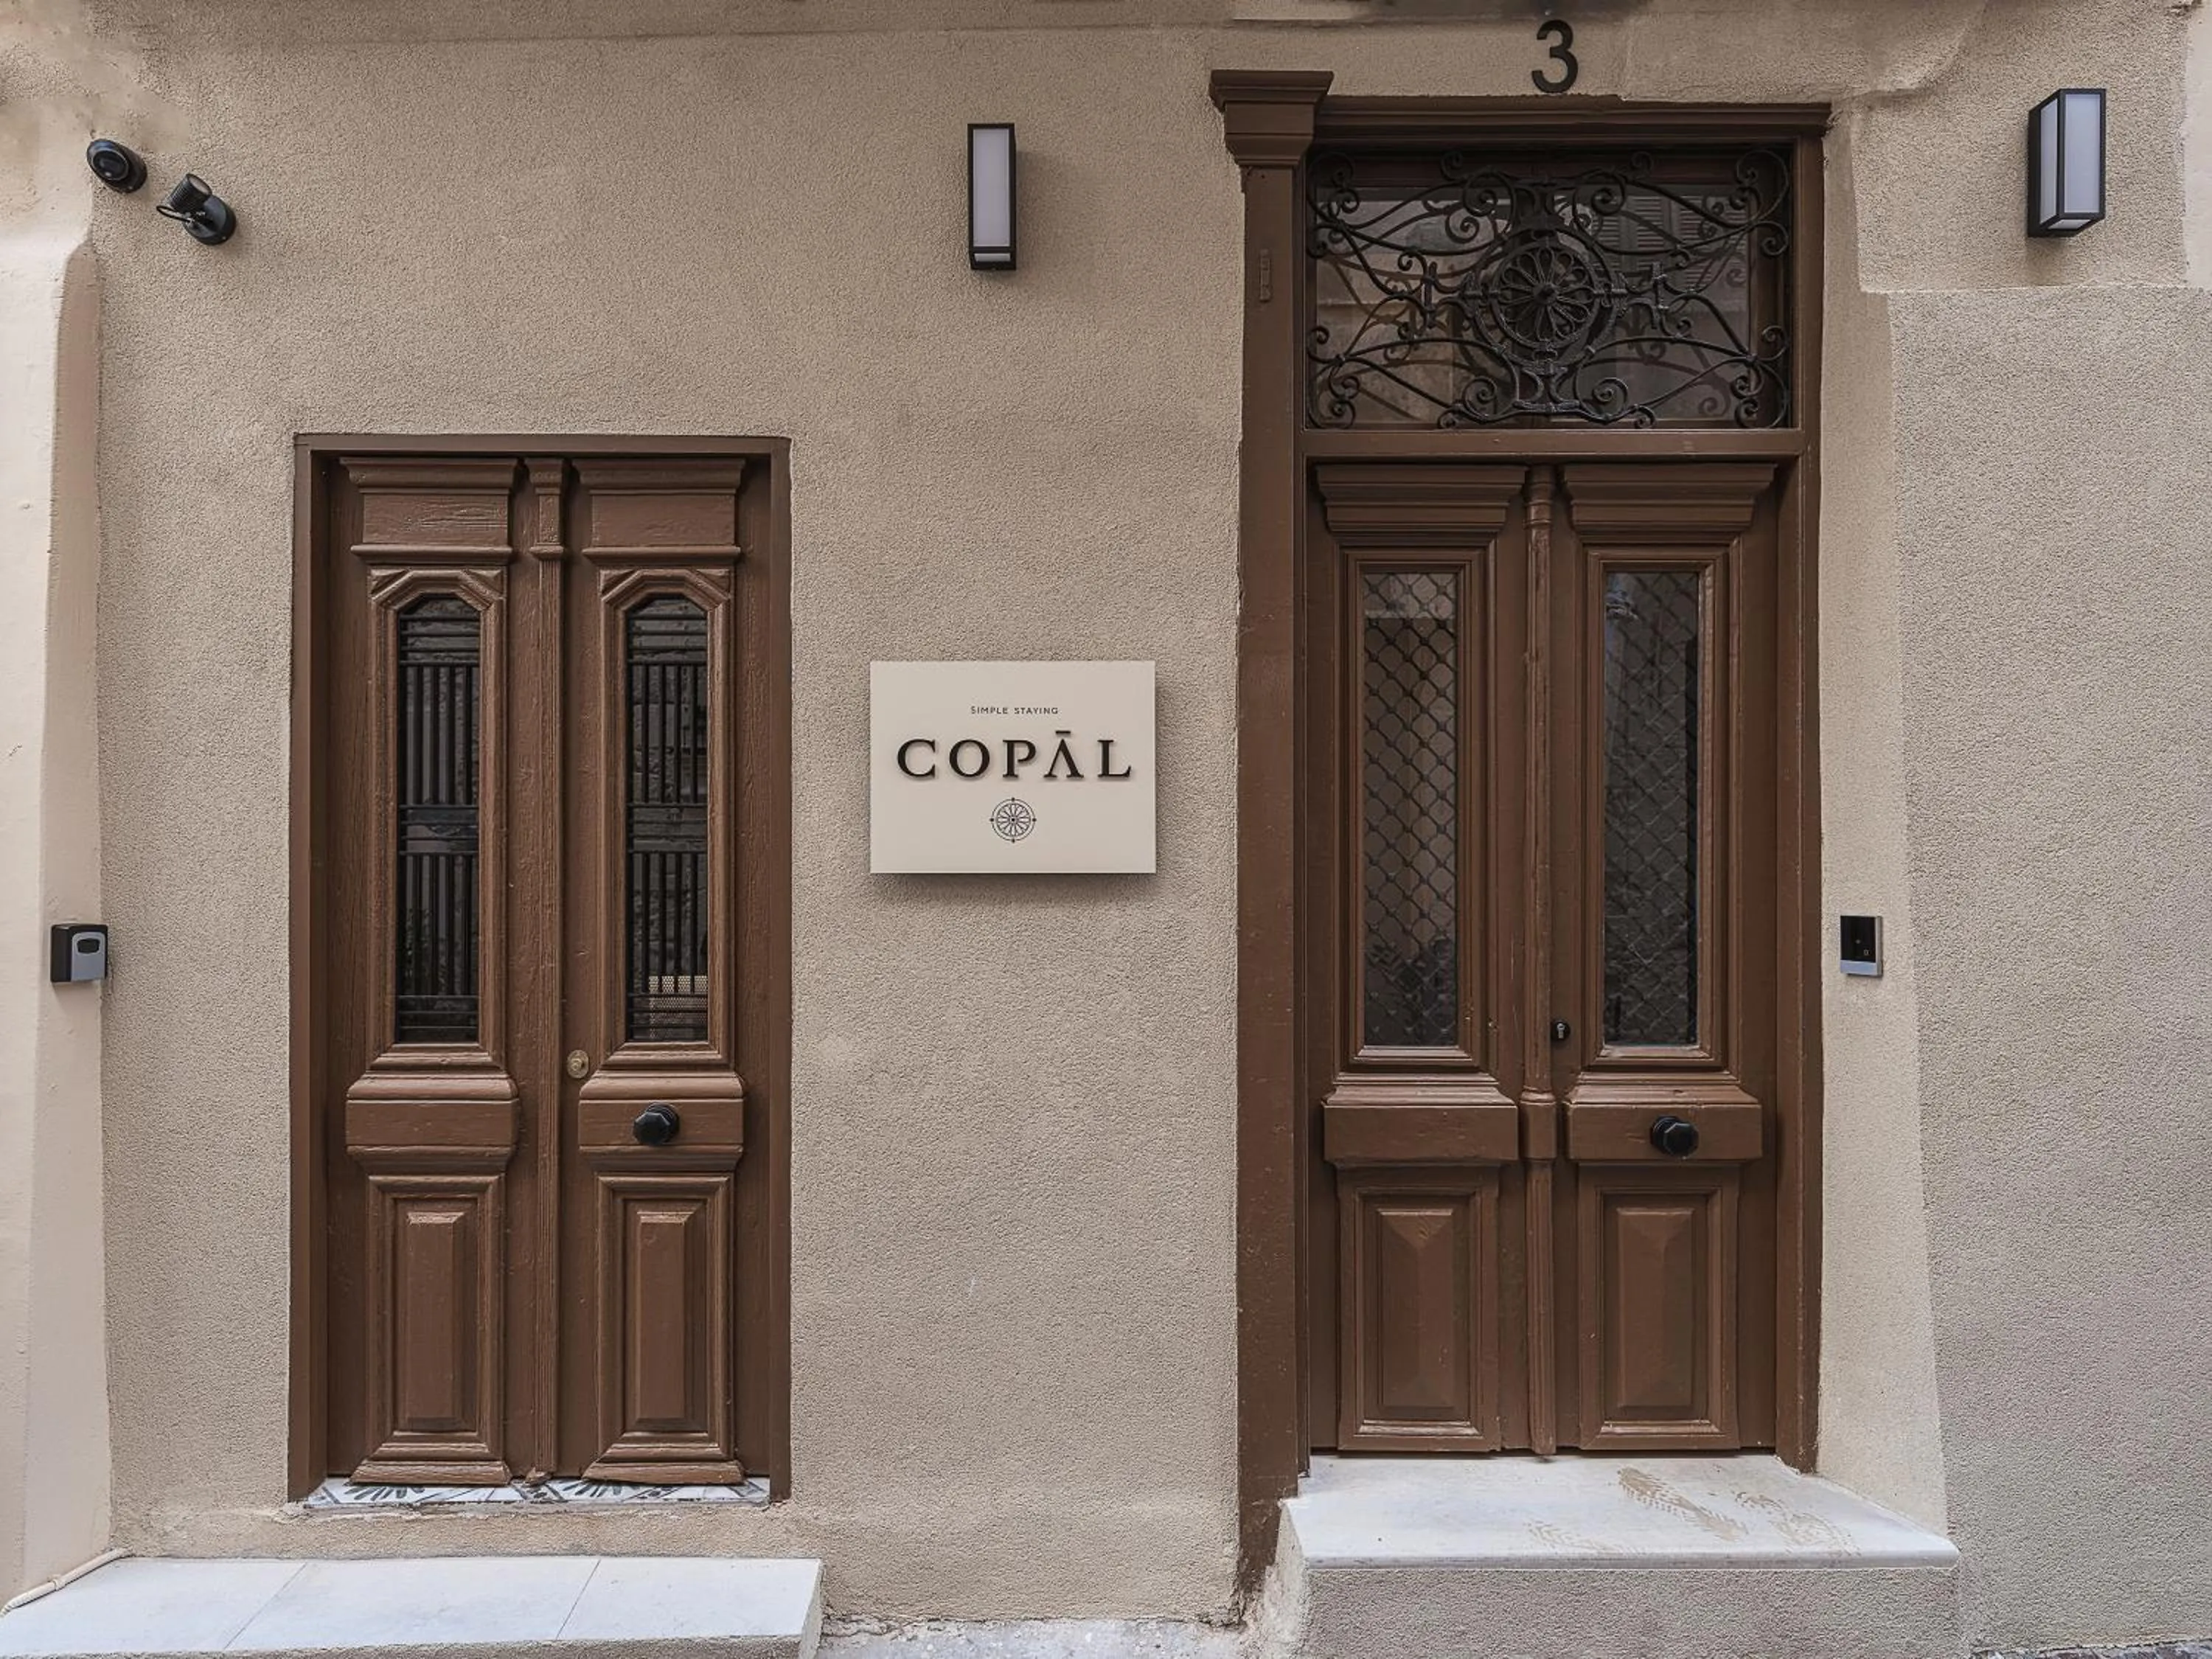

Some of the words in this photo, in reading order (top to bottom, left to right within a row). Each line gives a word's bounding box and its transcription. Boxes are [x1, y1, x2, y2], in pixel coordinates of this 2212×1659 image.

[1531, 19, 1578, 93] 3
[970, 706, 1009, 714] SIMPLE
[1014, 706, 1059, 715] STAYING
